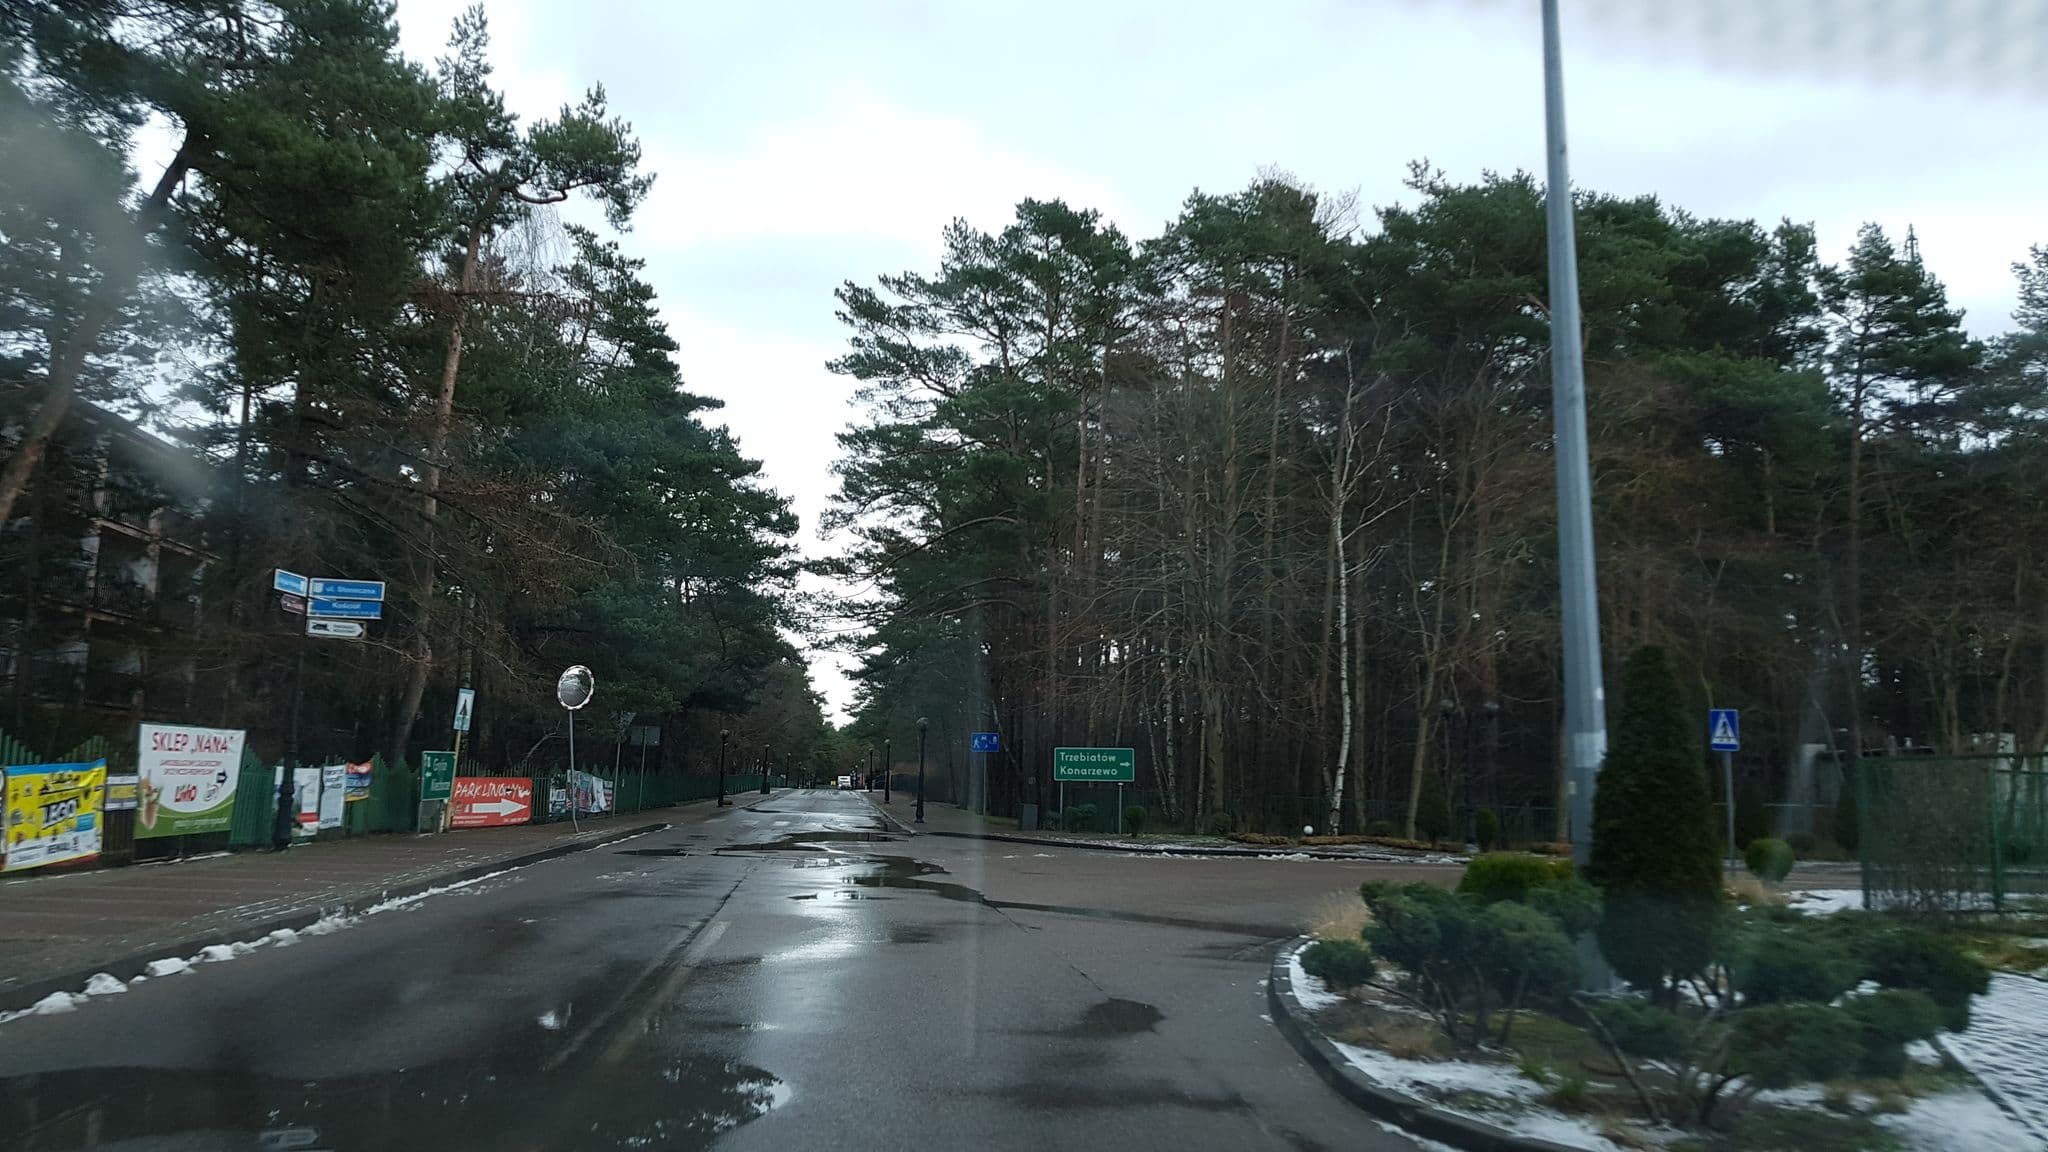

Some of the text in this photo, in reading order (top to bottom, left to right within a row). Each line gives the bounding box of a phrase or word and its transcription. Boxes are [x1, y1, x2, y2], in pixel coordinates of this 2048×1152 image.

[152, 731, 189, 752] SKLEP
[1060, 751, 1117, 762] Trzebiatów
[1060, 765, 1118, 776] Konarzewo
[454, 781, 481, 798] PARK
